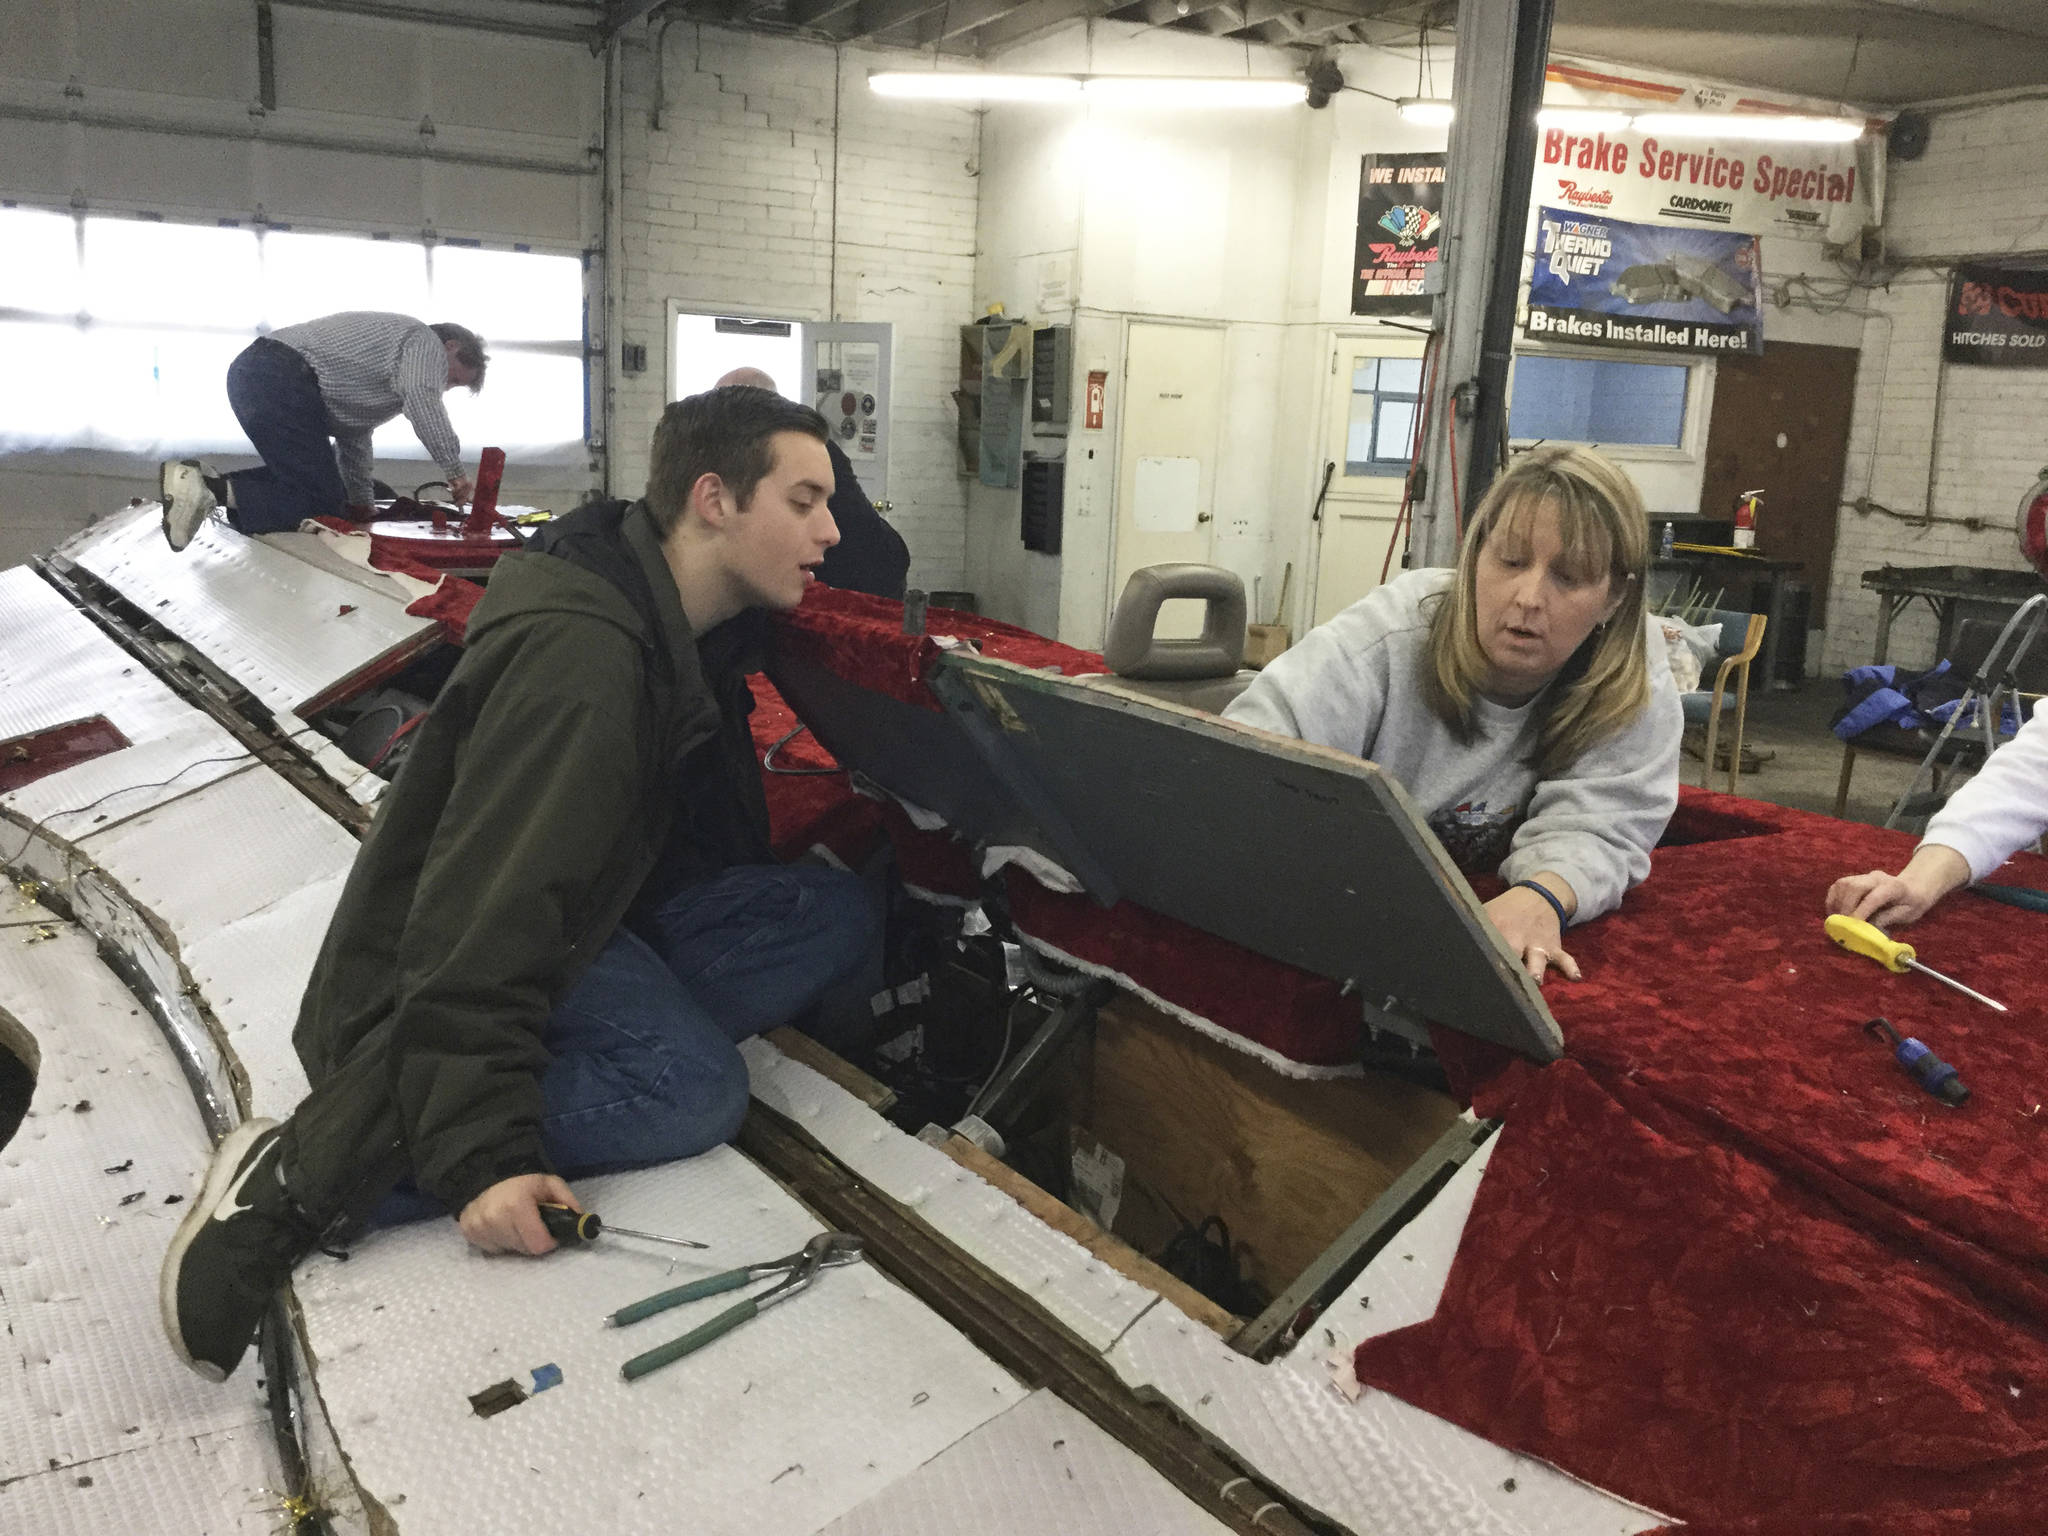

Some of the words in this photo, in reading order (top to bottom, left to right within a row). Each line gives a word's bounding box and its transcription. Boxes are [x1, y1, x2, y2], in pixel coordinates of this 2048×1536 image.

[1369, 167, 1395, 184] WE
[1543, 128, 1628, 174] Brake
[1639, 137, 1745, 190] Service
[1753, 155, 1856, 203] Special
[1669, 194, 1724, 212] CARDONE
[1542, 220, 1612, 258] THERMO
[1563, 220, 1609, 238] WAGNER
[1549, 249, 1606, 286] QUIET
[1529, 311, 1603, 338] Brakes
[1606, 320, 1689, 346] Installed
[1695, 328, 1748, 349] Here!
[1952, 331, 2008, 346] HITCHES
[2008, 334, 2047, 348] SOLD
